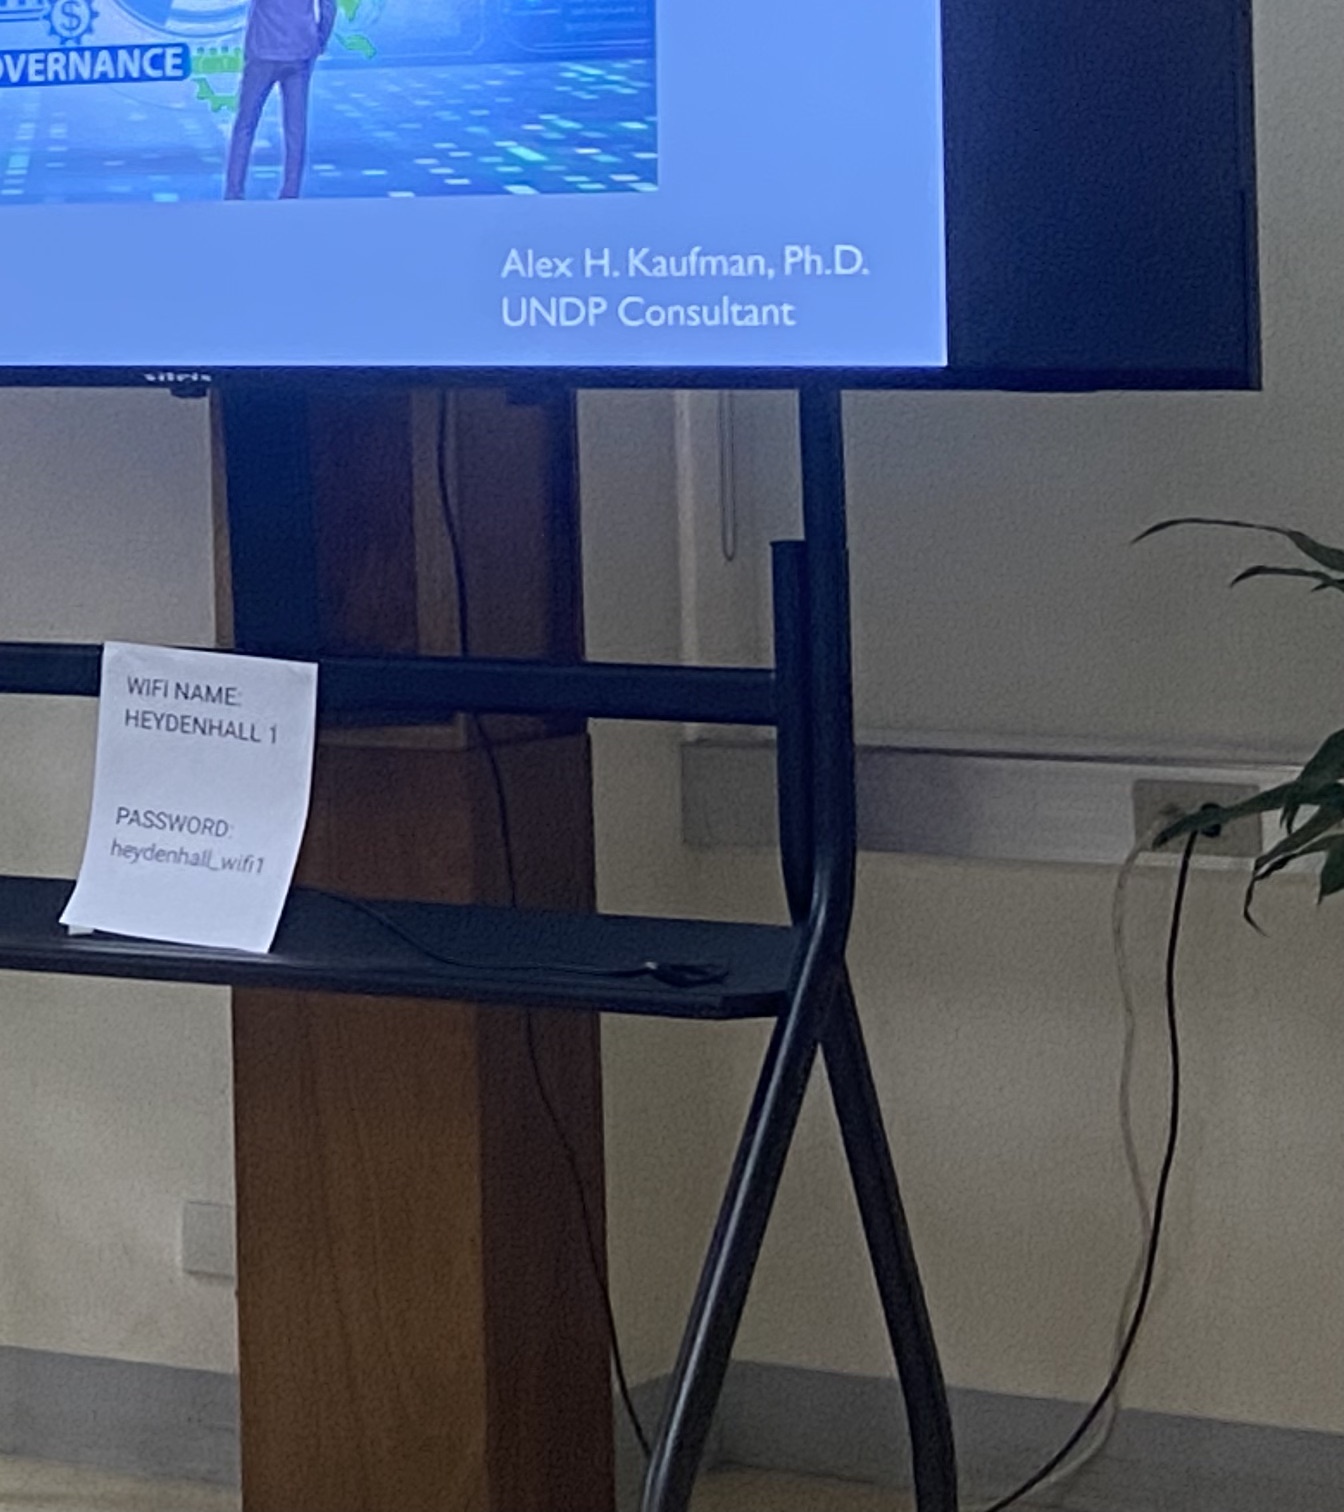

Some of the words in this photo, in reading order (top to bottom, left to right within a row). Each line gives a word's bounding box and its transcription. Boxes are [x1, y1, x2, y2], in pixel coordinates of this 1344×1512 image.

[500, 248, 574, 278] Alex
[583, 247, 620, 278] H.
[627, 245, 775, 280] Kaufman,
[784, 243, 871, 276] Ph.D.
[501, 296, 608, 327] UNDP
[616, 295, 797, 327] Consultant
[126, 675, 169, 698] WIFI
[124, 708, 262, 743] HEYDENHALL
[268, 724, 278, 745] 1
[109, 838, 265, 875] heydenhall_wifi1
